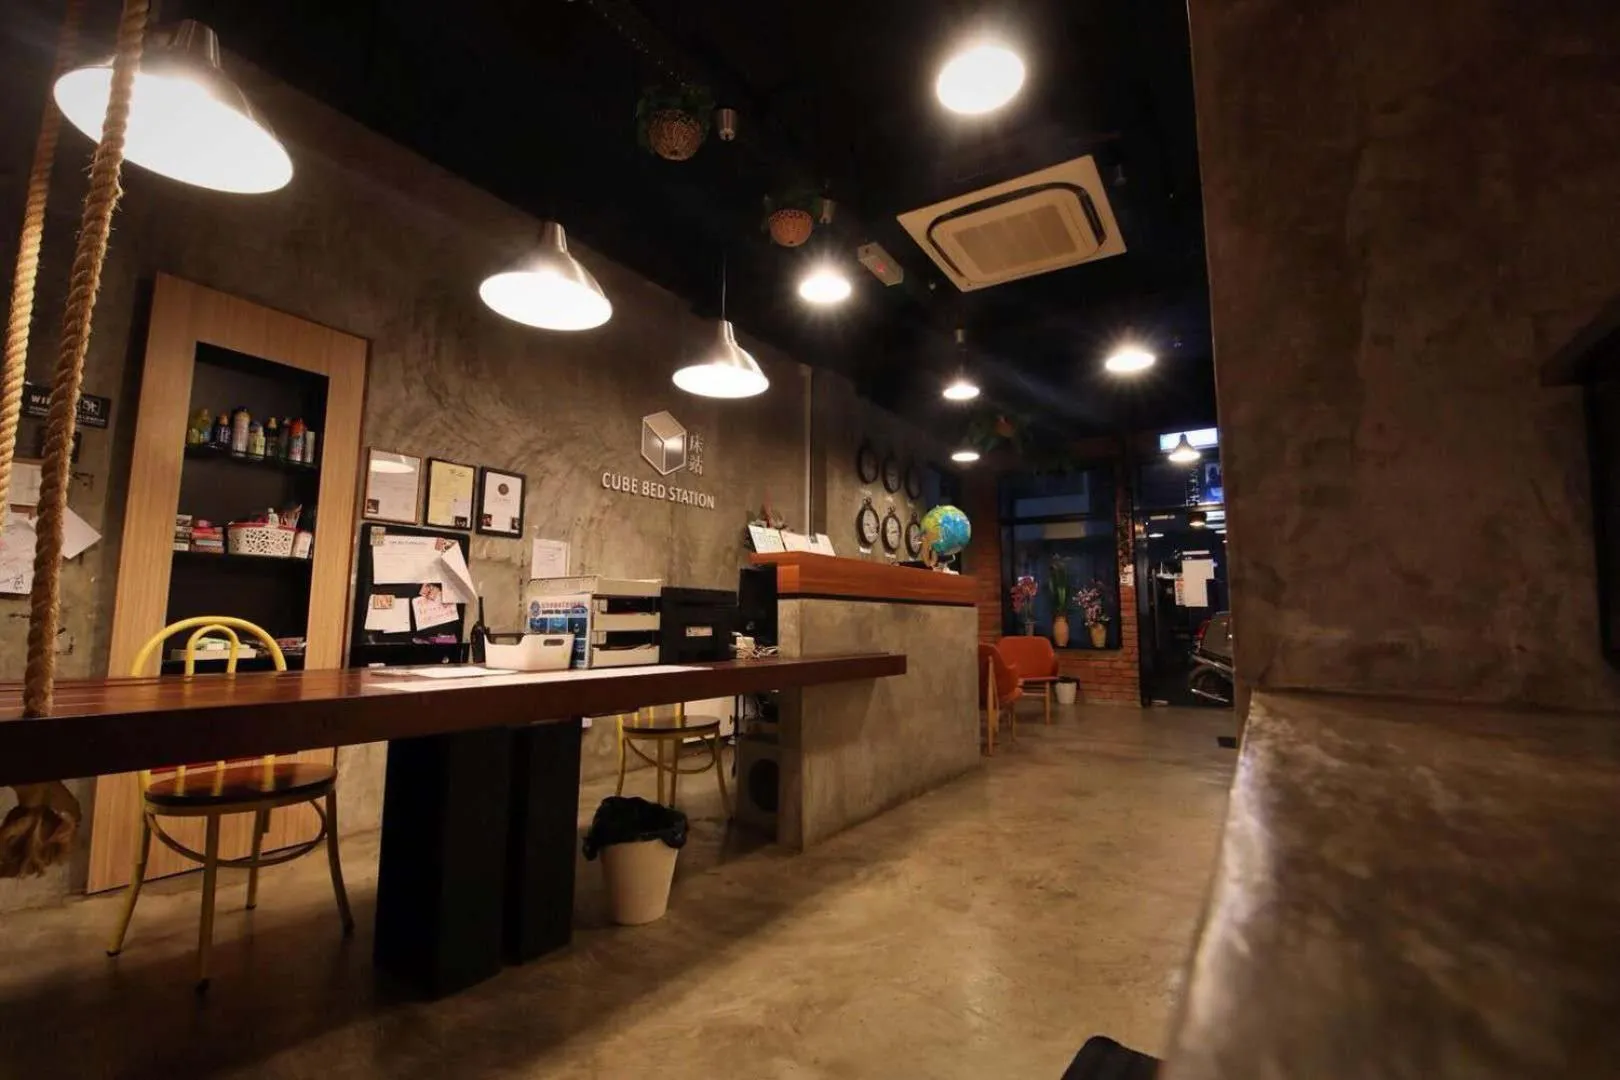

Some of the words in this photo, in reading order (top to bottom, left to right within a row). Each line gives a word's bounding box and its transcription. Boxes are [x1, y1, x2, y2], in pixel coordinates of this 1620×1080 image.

[602, 472, 638, 494] CUBE
[641, 480, 666, 499] BED
[669, 487, 715, 509] STATION
